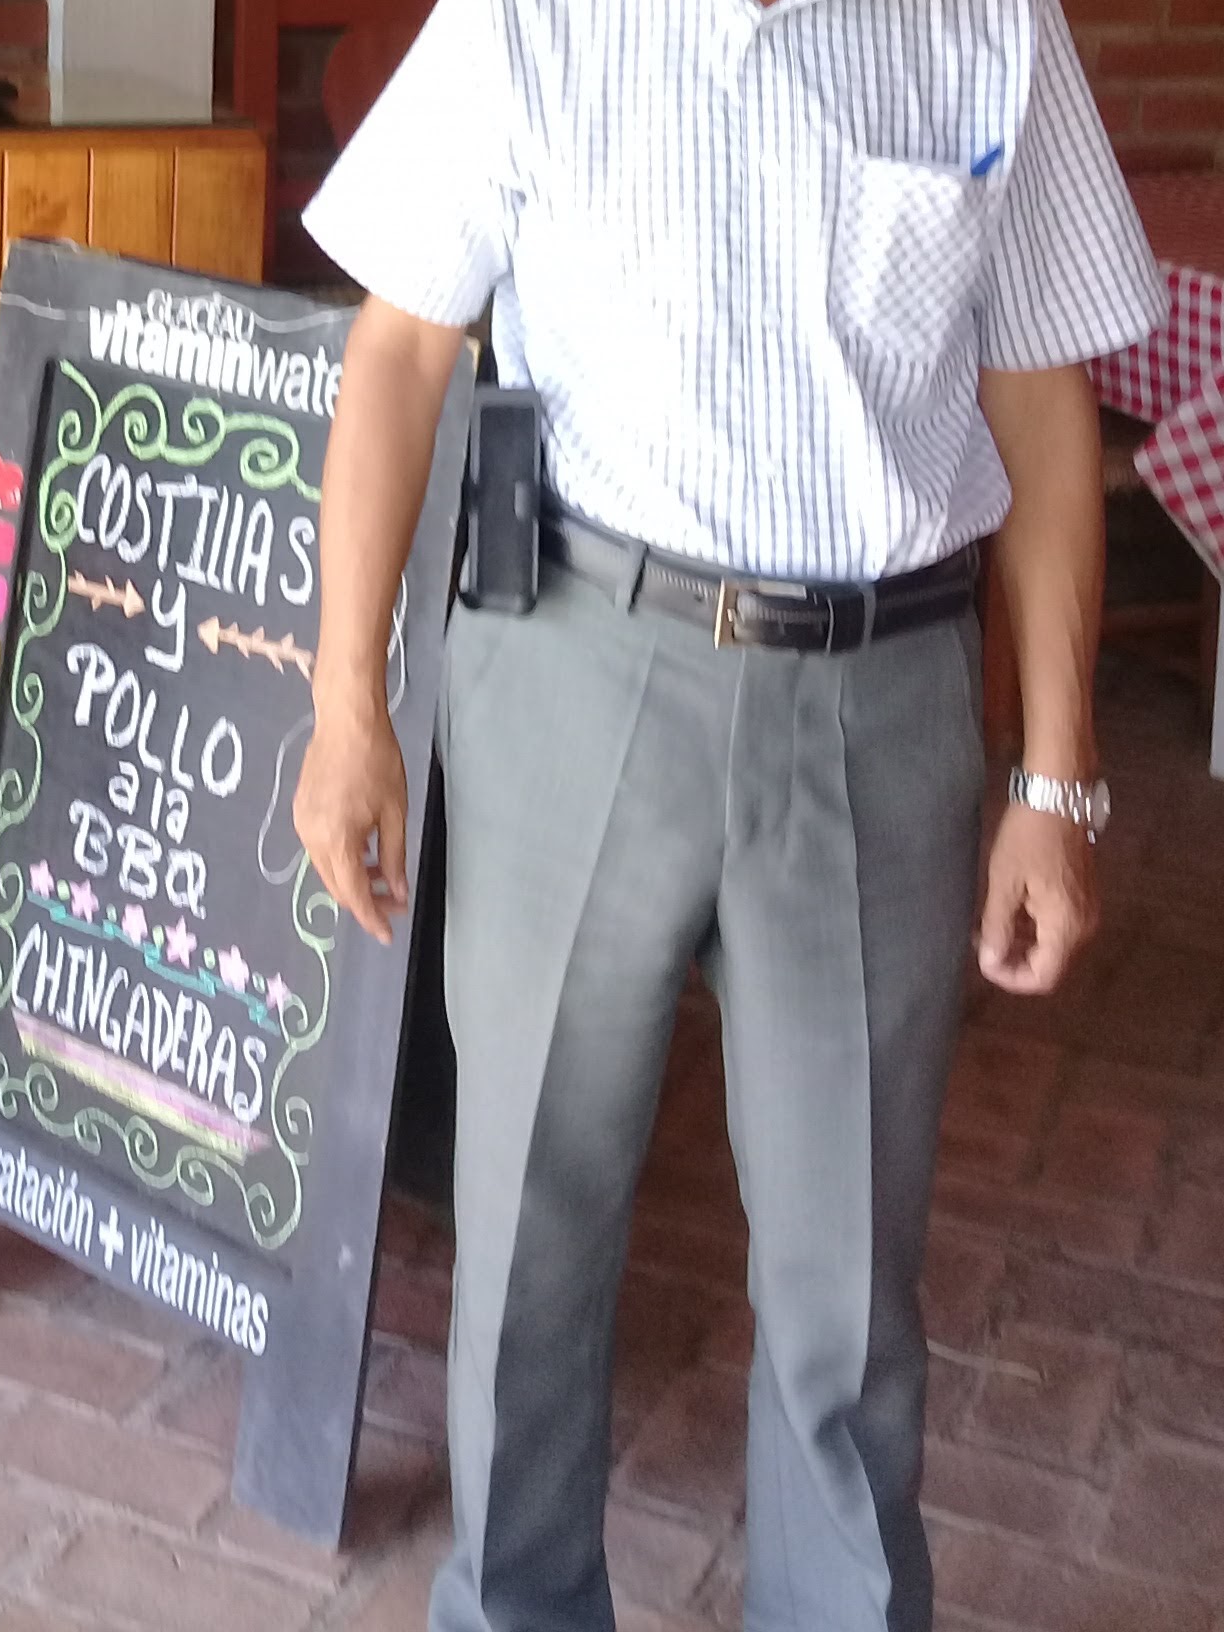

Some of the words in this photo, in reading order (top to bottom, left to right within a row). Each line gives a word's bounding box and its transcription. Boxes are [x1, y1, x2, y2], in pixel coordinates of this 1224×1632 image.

[89, 299, 344, 419] vitaminwate
[66, 642, 244, 798] POLLO
[68, 798, 207, 921] BBQ
[11, 921, 267, 1124] CHINGADERAS
[130, 1216, 270, 1358] vitaminas
